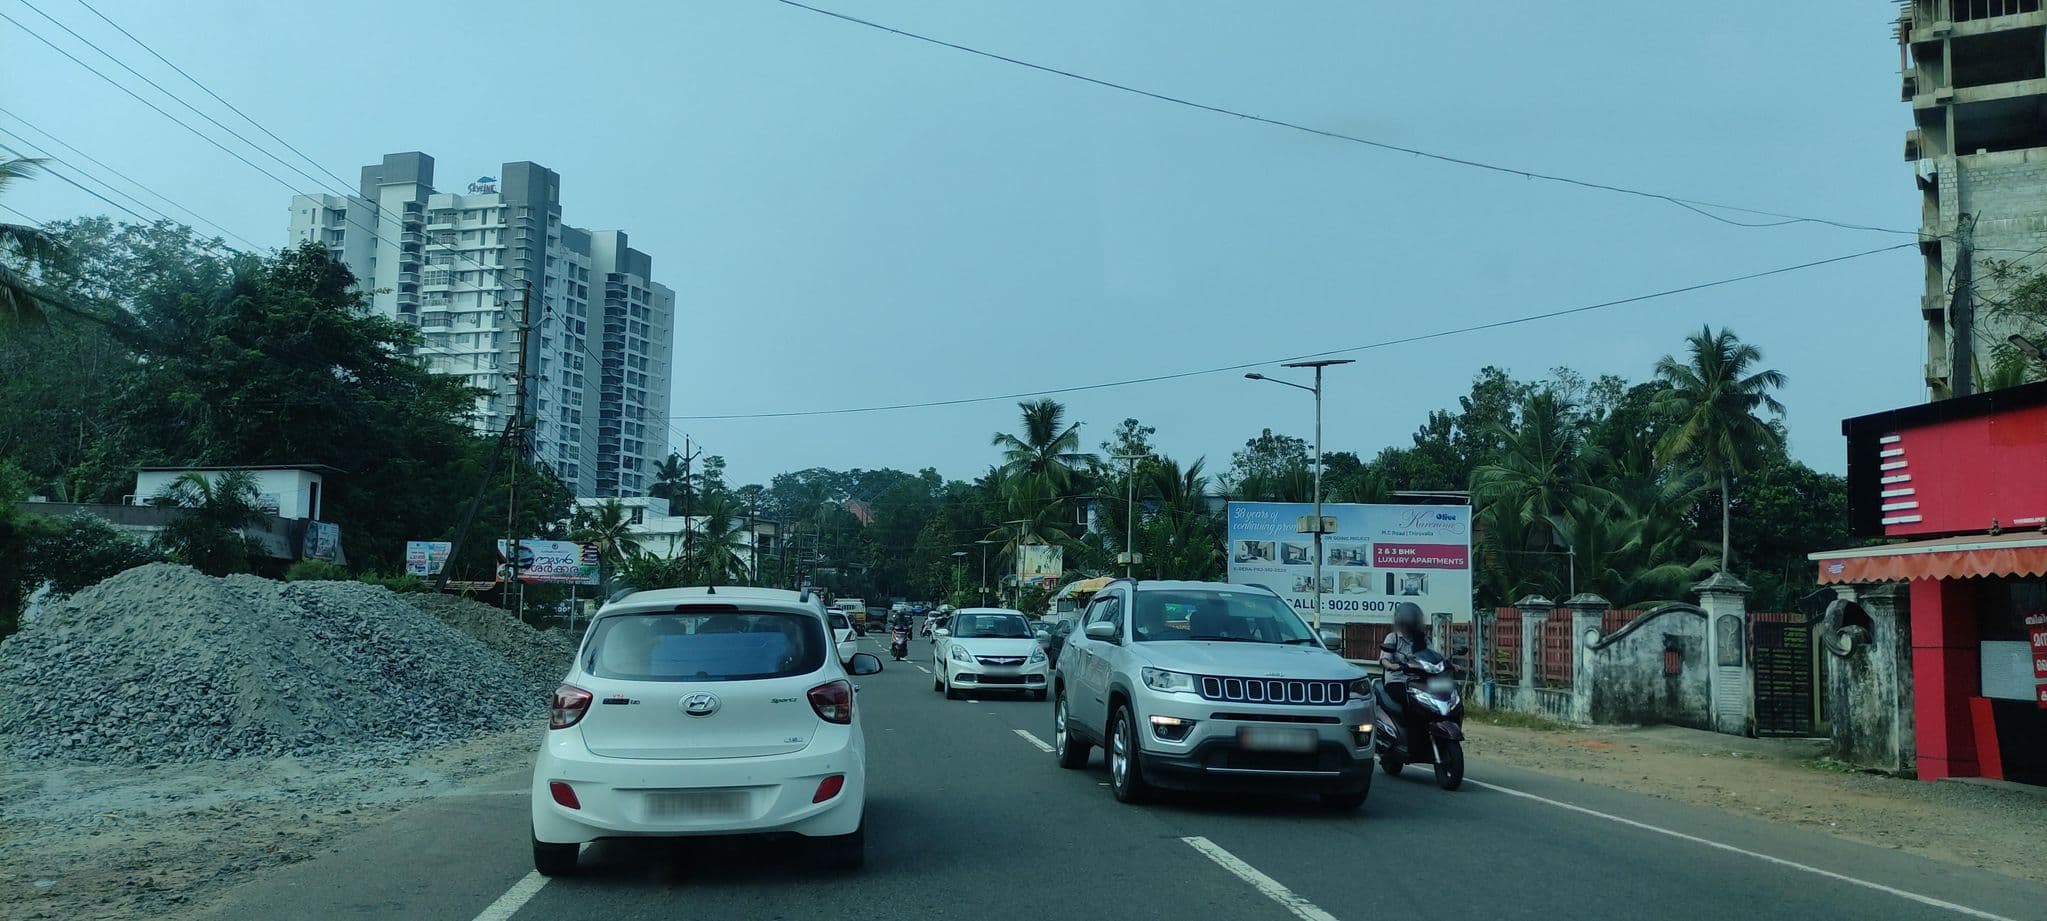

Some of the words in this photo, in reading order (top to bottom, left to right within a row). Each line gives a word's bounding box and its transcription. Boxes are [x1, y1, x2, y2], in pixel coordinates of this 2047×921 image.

[1436, 513, 1456, 521] Olive
[1410, 557, 1464, 565] APARTMENTS
[1328, 599, 1359, 611] 9020
[1362, 600, 1385, 612] 900
